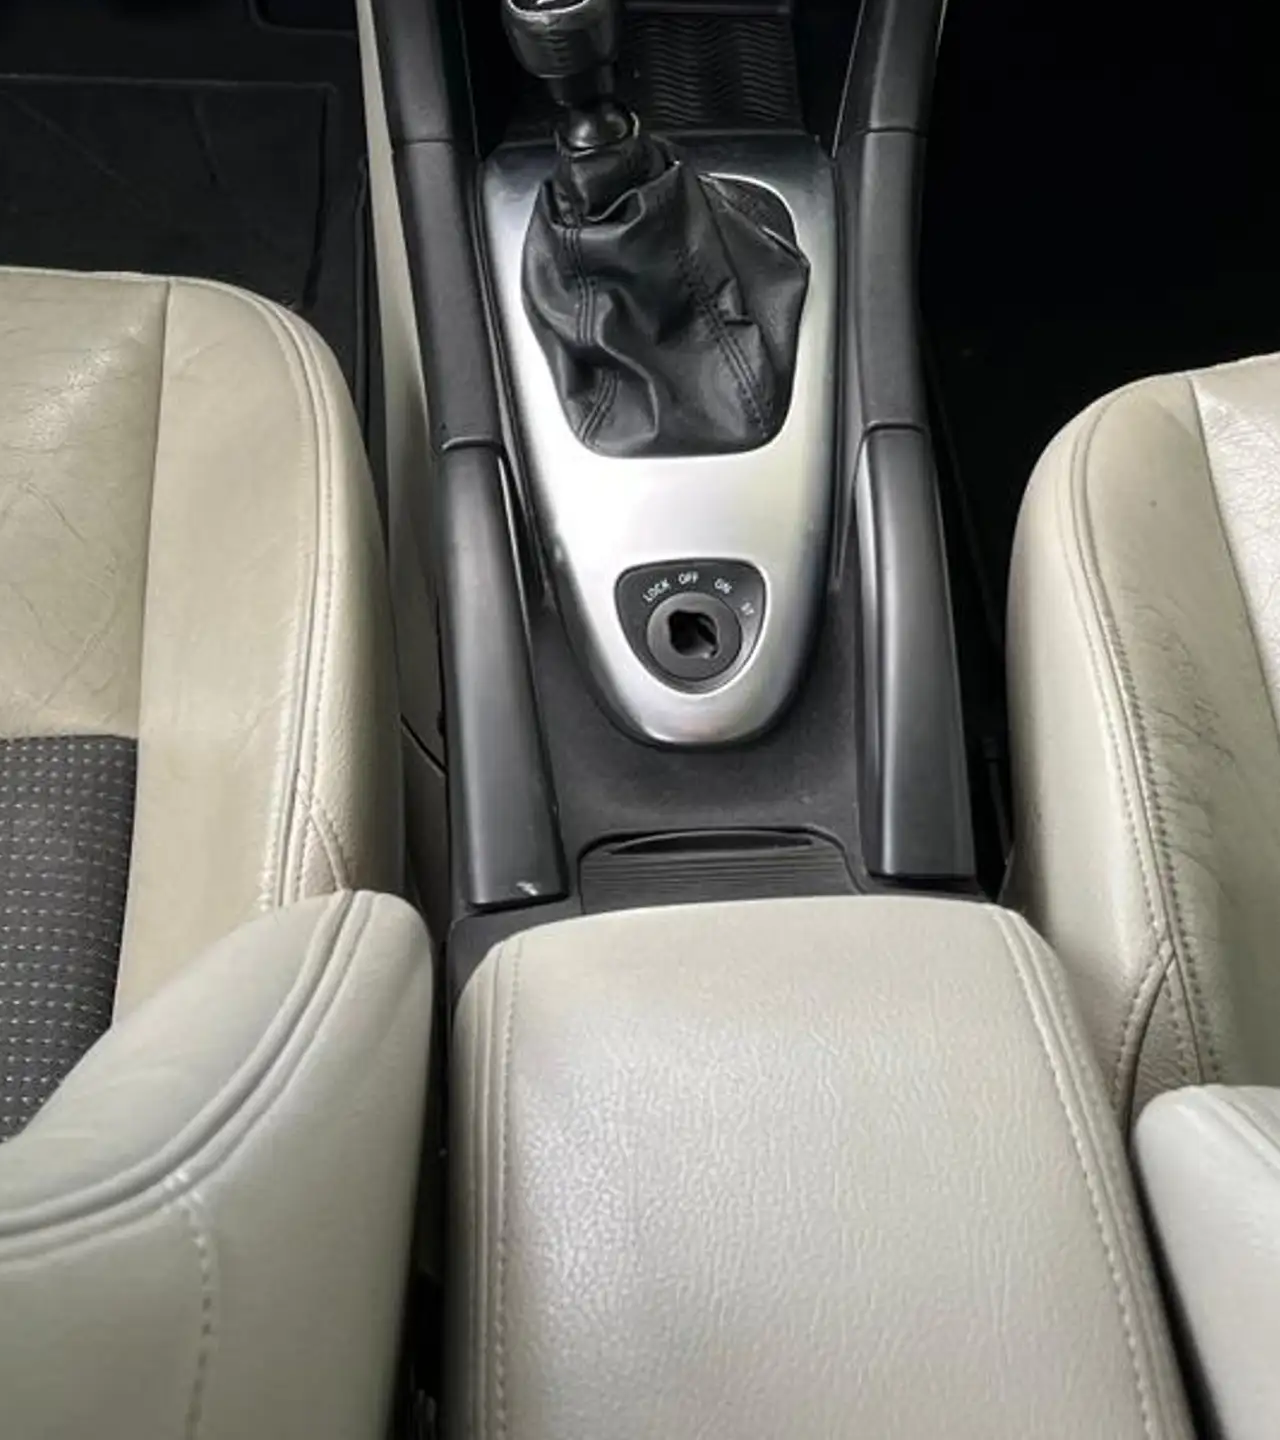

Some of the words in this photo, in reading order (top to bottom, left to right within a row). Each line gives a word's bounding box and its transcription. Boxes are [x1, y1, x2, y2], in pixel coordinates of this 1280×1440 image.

[678, 571, 699, 585] OFF
[714, 578, 733, 594] ON
[642, 578, 671, 602] LOCK
